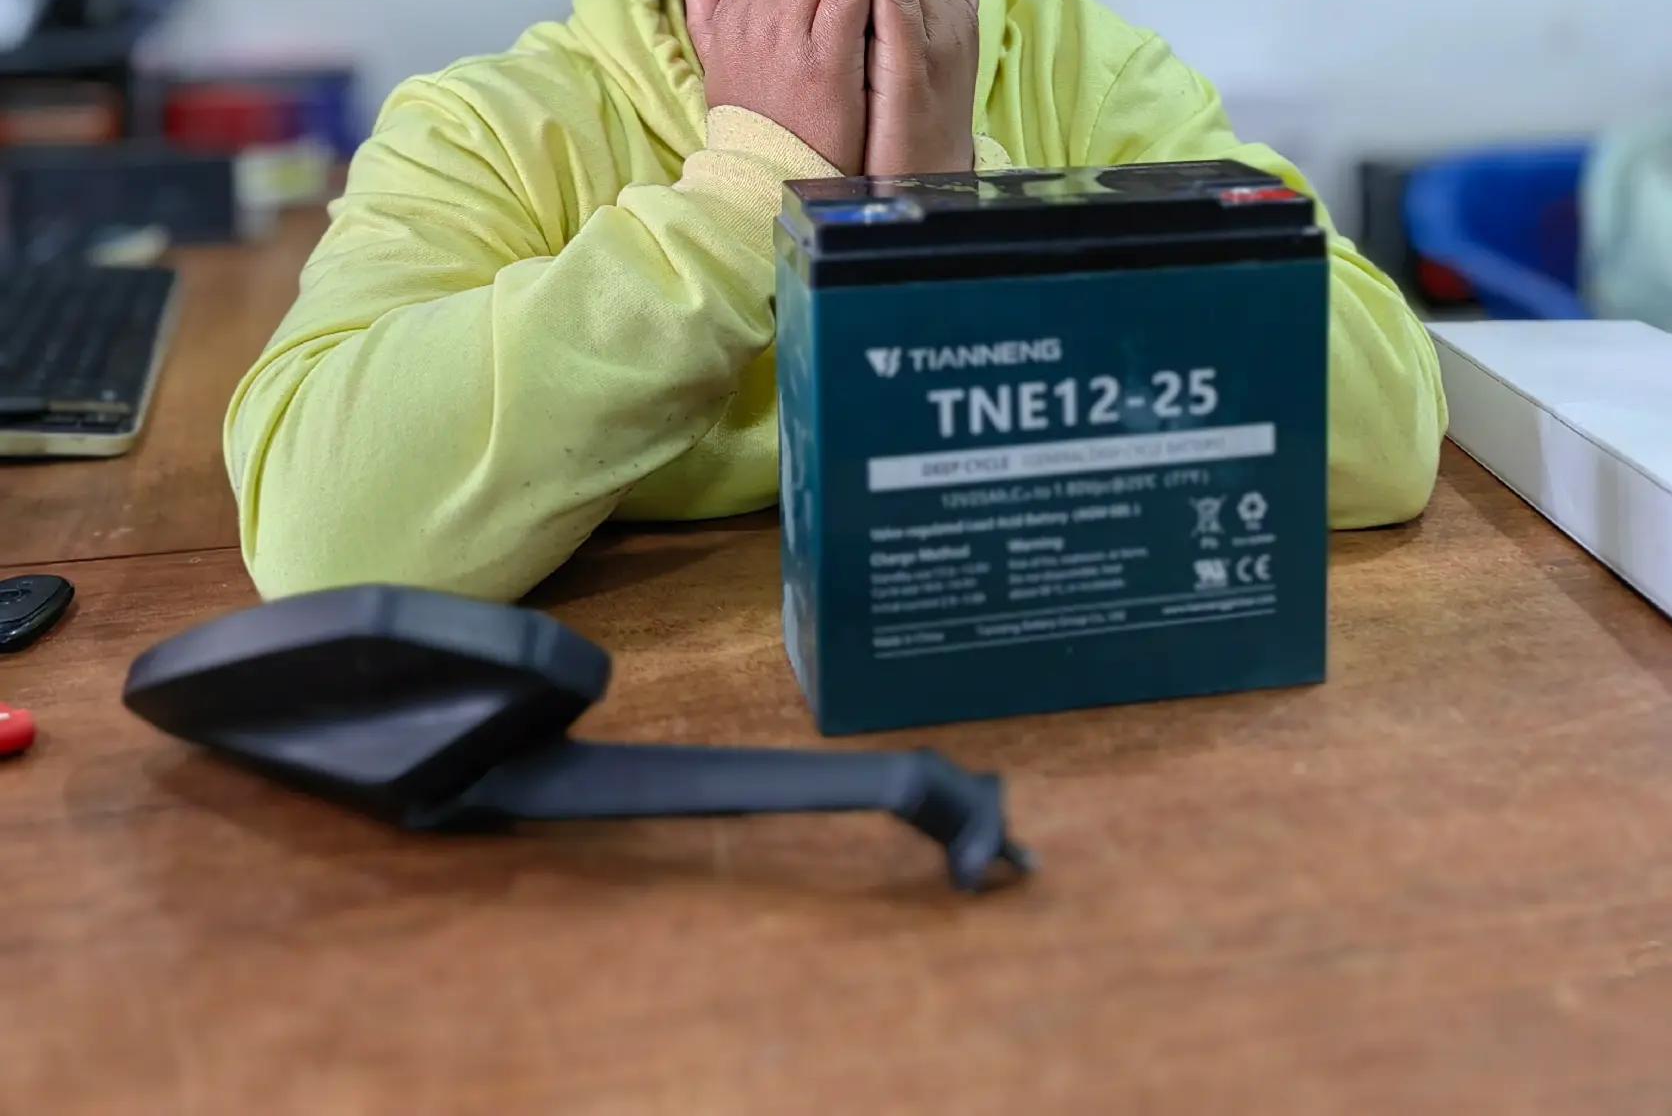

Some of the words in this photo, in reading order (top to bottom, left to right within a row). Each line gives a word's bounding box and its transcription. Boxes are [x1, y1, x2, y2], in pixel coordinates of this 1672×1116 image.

[907, 338, 1063, 372] TIANNENG
[927, 368, 1219, 437] TNE12-25
[1236, 553, 1272, 583] CE
